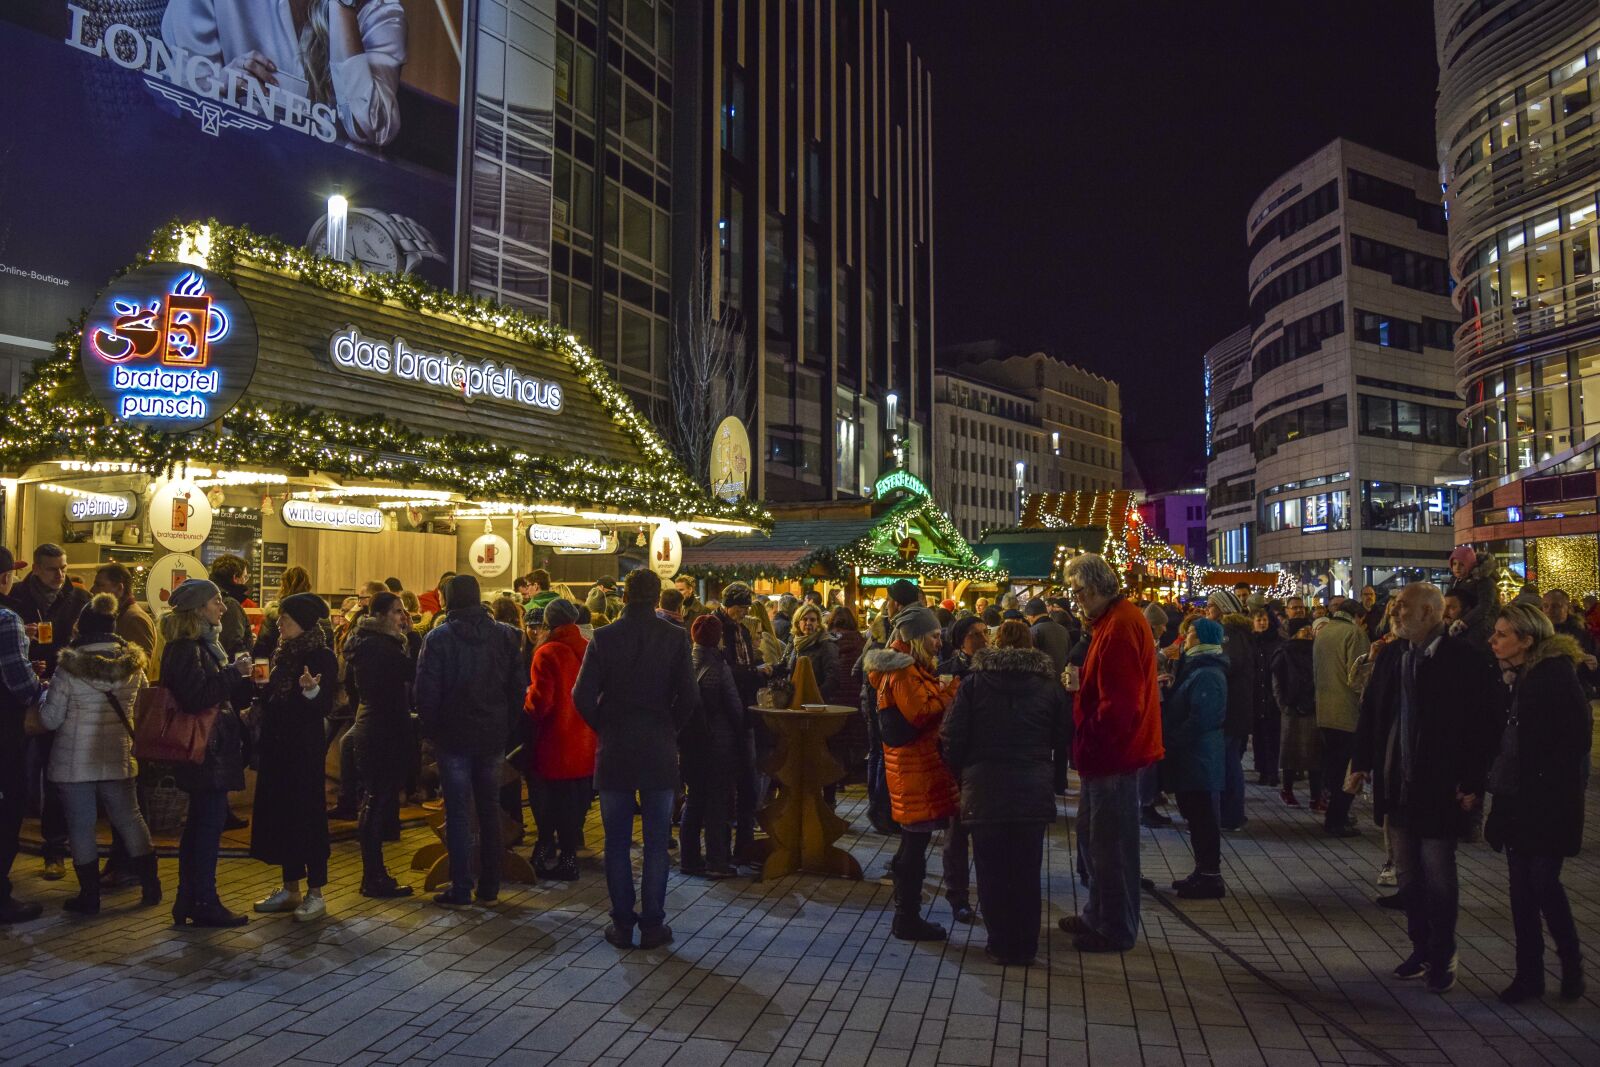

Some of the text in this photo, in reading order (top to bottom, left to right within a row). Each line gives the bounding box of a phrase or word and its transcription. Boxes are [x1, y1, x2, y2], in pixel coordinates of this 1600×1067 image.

[64, 3, 338, 143] LONGINES
[0, 263, 71, 287] Online-Boutique
[333, 330, 391, 373] das
[114, 365, 219, 395] bratapfel
[122, 395, 206, 419] punsch
[288, 505, 382, 526] winterapfelsaft
